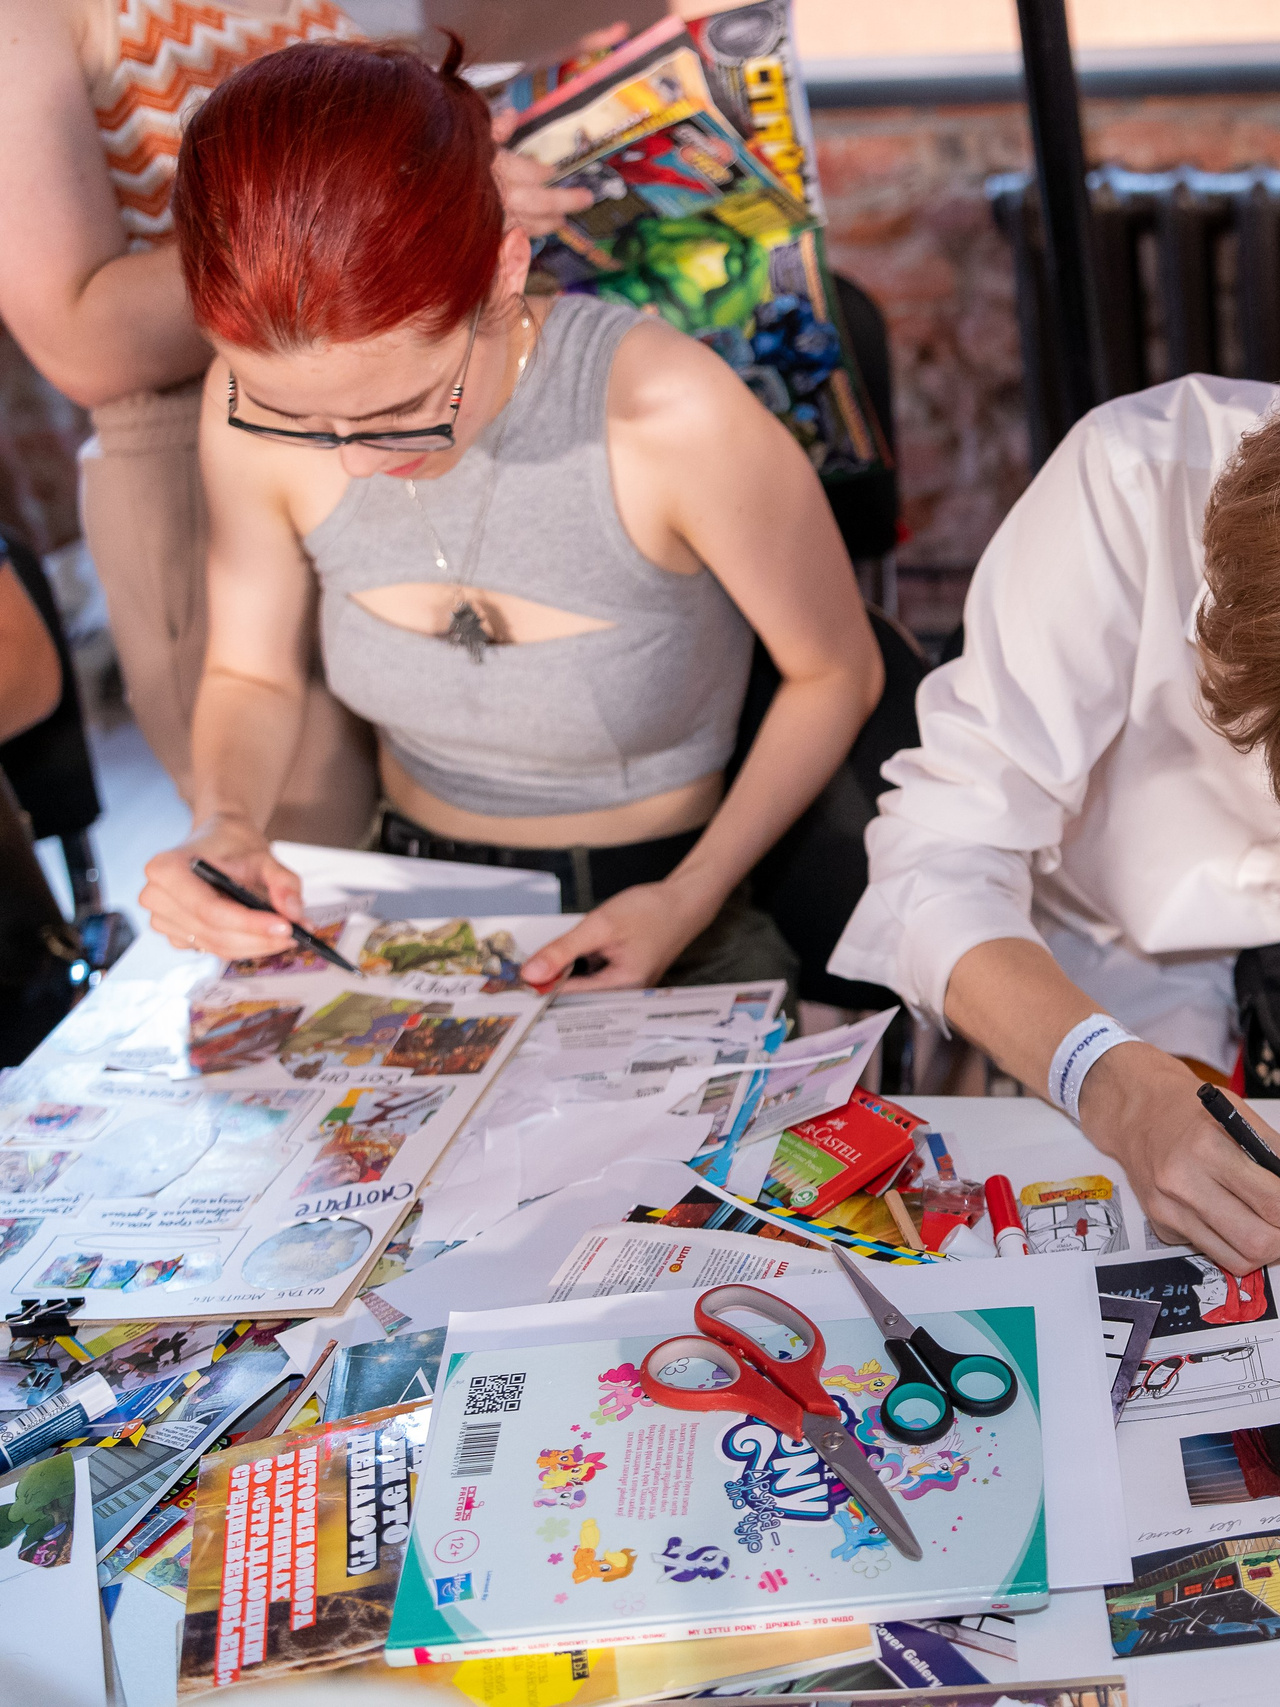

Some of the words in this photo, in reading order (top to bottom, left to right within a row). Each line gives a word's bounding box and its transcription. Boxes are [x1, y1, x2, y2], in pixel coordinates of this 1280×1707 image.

[674, 1244, 691, 1264] ШАГ
[254, 1458, 273, 1484] СО
[277, 1451, 296, 1467] В
[296, 1445, 319, 1546] ИСТОРИЯ
[381, 1483, 410, 1544] ЭТО
[454, 1486, 468, 1523] FACTORY
[271, 1467, 295, 1603] КАРТИНКАХ
[450, 1536, 465, 1557] 12+
[218, 1464, 251, 1687] СРЕДНЕВЕКОВЬЕМ»
[242, 1486, 271, 1667] «СТРАДАЮЩИМ
[293, 1545, 316, 1631] ЮМОРА
[688, 1628, 702, 1637] MY
[702, 1626, 730, 1635] LITTLE
[734, 1623, 757, 1633] PONY
[765, 1620, 801, 1630] ДРУЖБА
[812, 1617, 829, 1625] ЭТО
[830, 1615, 854, 1623] ЧУДО
[572, 1650, 589, 1679] ТЬЕ
[903, 1649, 944, 1688] Gallery
